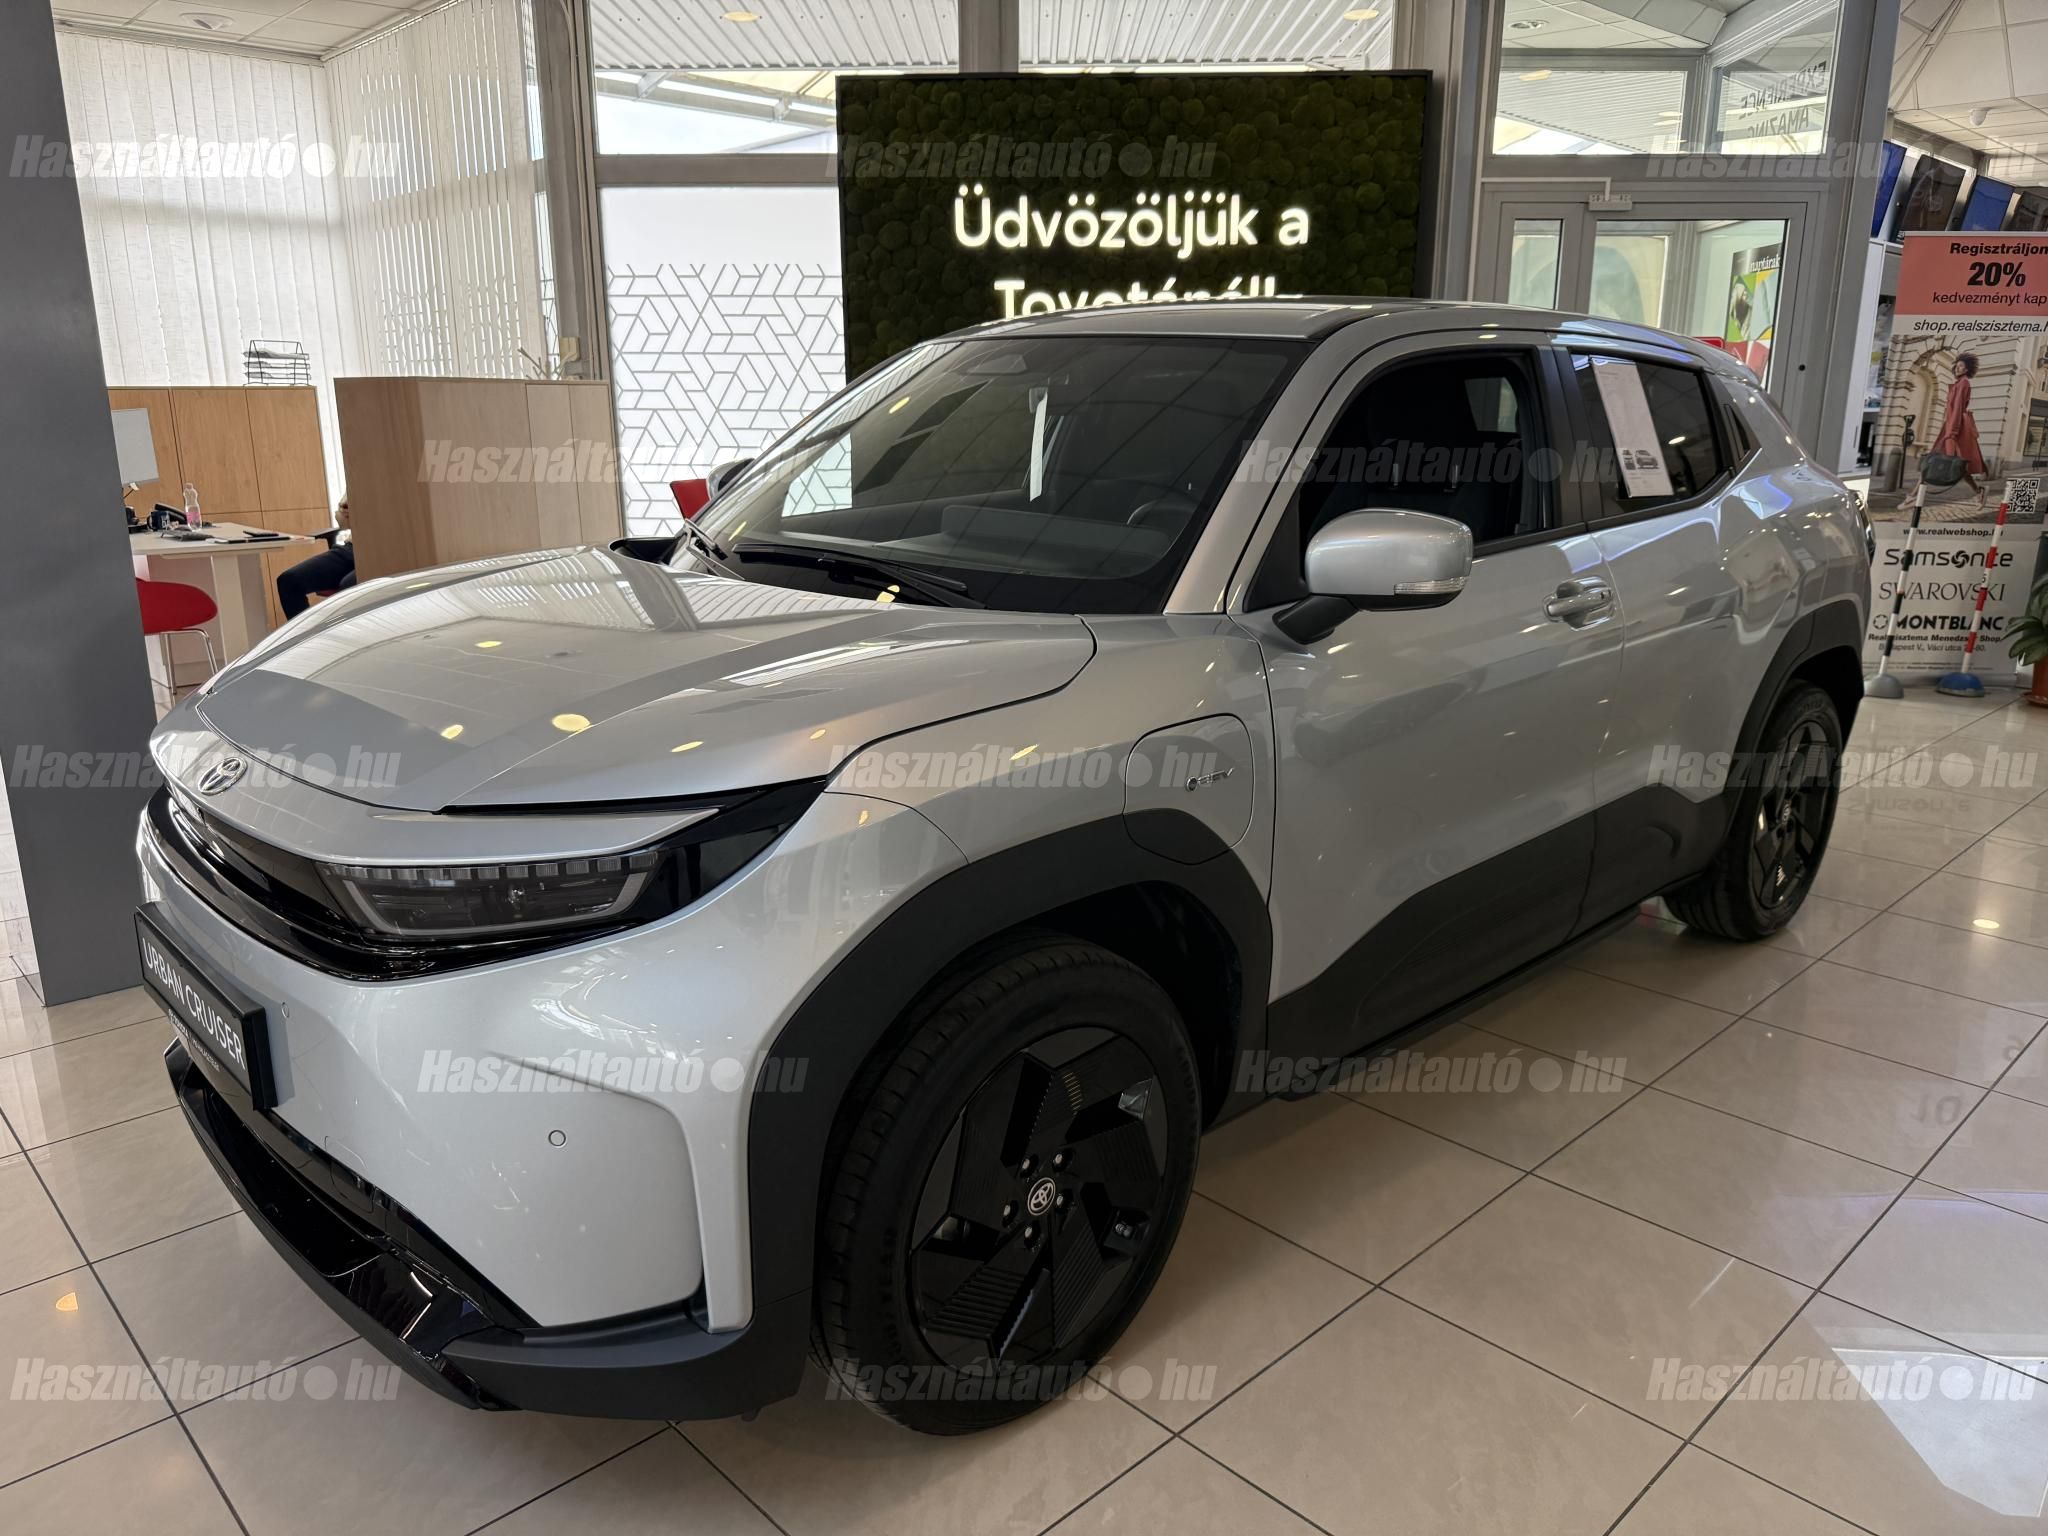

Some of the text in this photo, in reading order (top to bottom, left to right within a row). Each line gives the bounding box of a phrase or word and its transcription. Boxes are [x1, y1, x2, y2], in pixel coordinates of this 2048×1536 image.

[953, 184, 1310, 259] Üdvözöljük a
[1967, 261, 2026, 287] 20%
[1932, 292, 2048, 307] kedvezményt kap
[1903, 528, 2003, 537] ww.realwebshop.
[1896, 614, 2004, 631] MONTBLNC
[142, 937, 185, 1006] URBAN
[185, 984, 246, 1071] CRUISER
